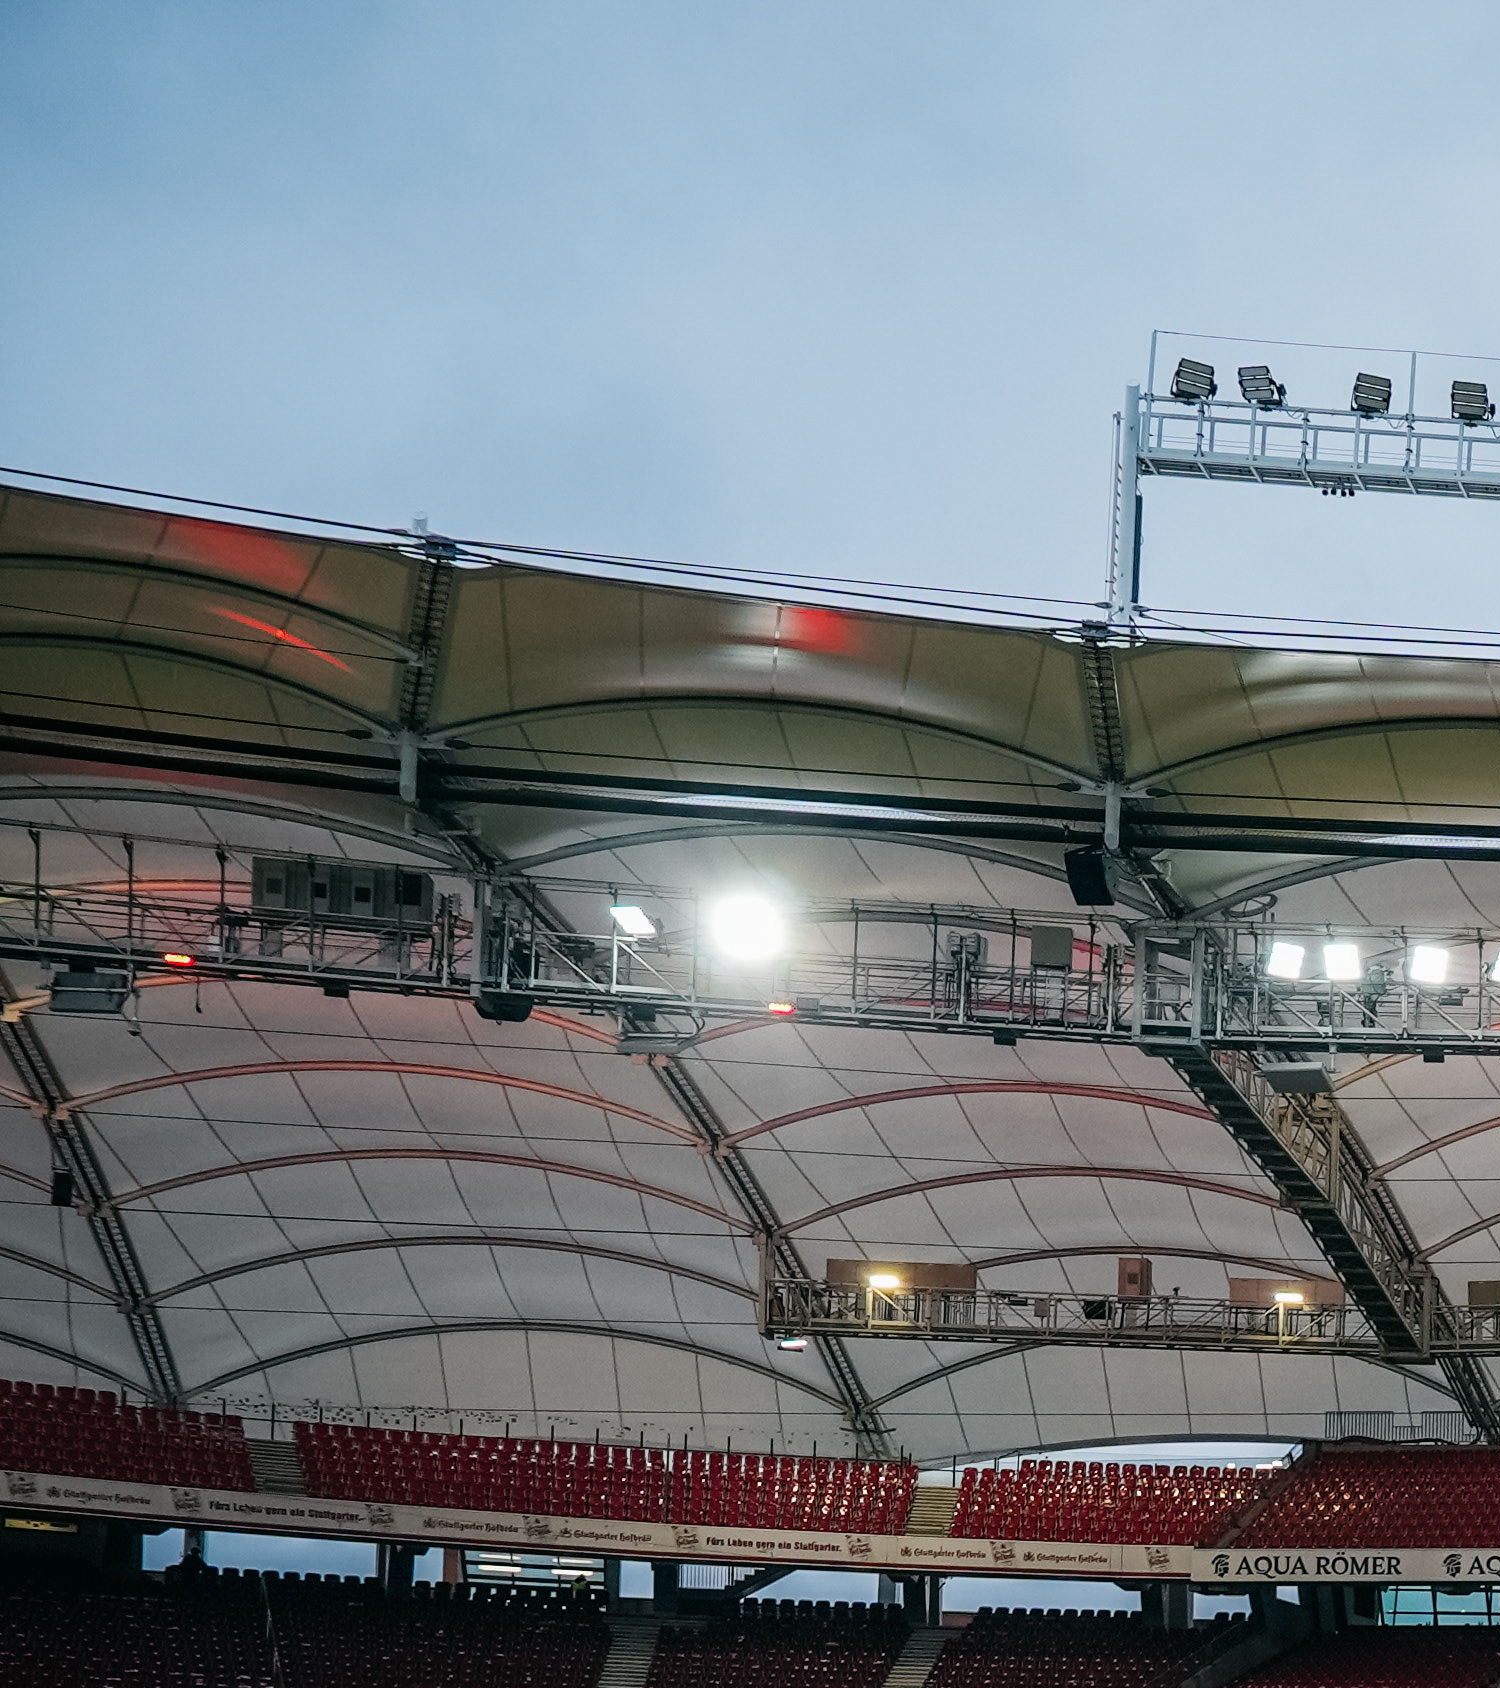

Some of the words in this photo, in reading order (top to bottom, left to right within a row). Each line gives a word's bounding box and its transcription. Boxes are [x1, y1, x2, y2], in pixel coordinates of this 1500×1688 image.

[706, 1536, 725, 1547] Fürs
[1235, 1554, 1308, 1579] AQUA
[1315, 1551, 1402, 1575] RÖMER
